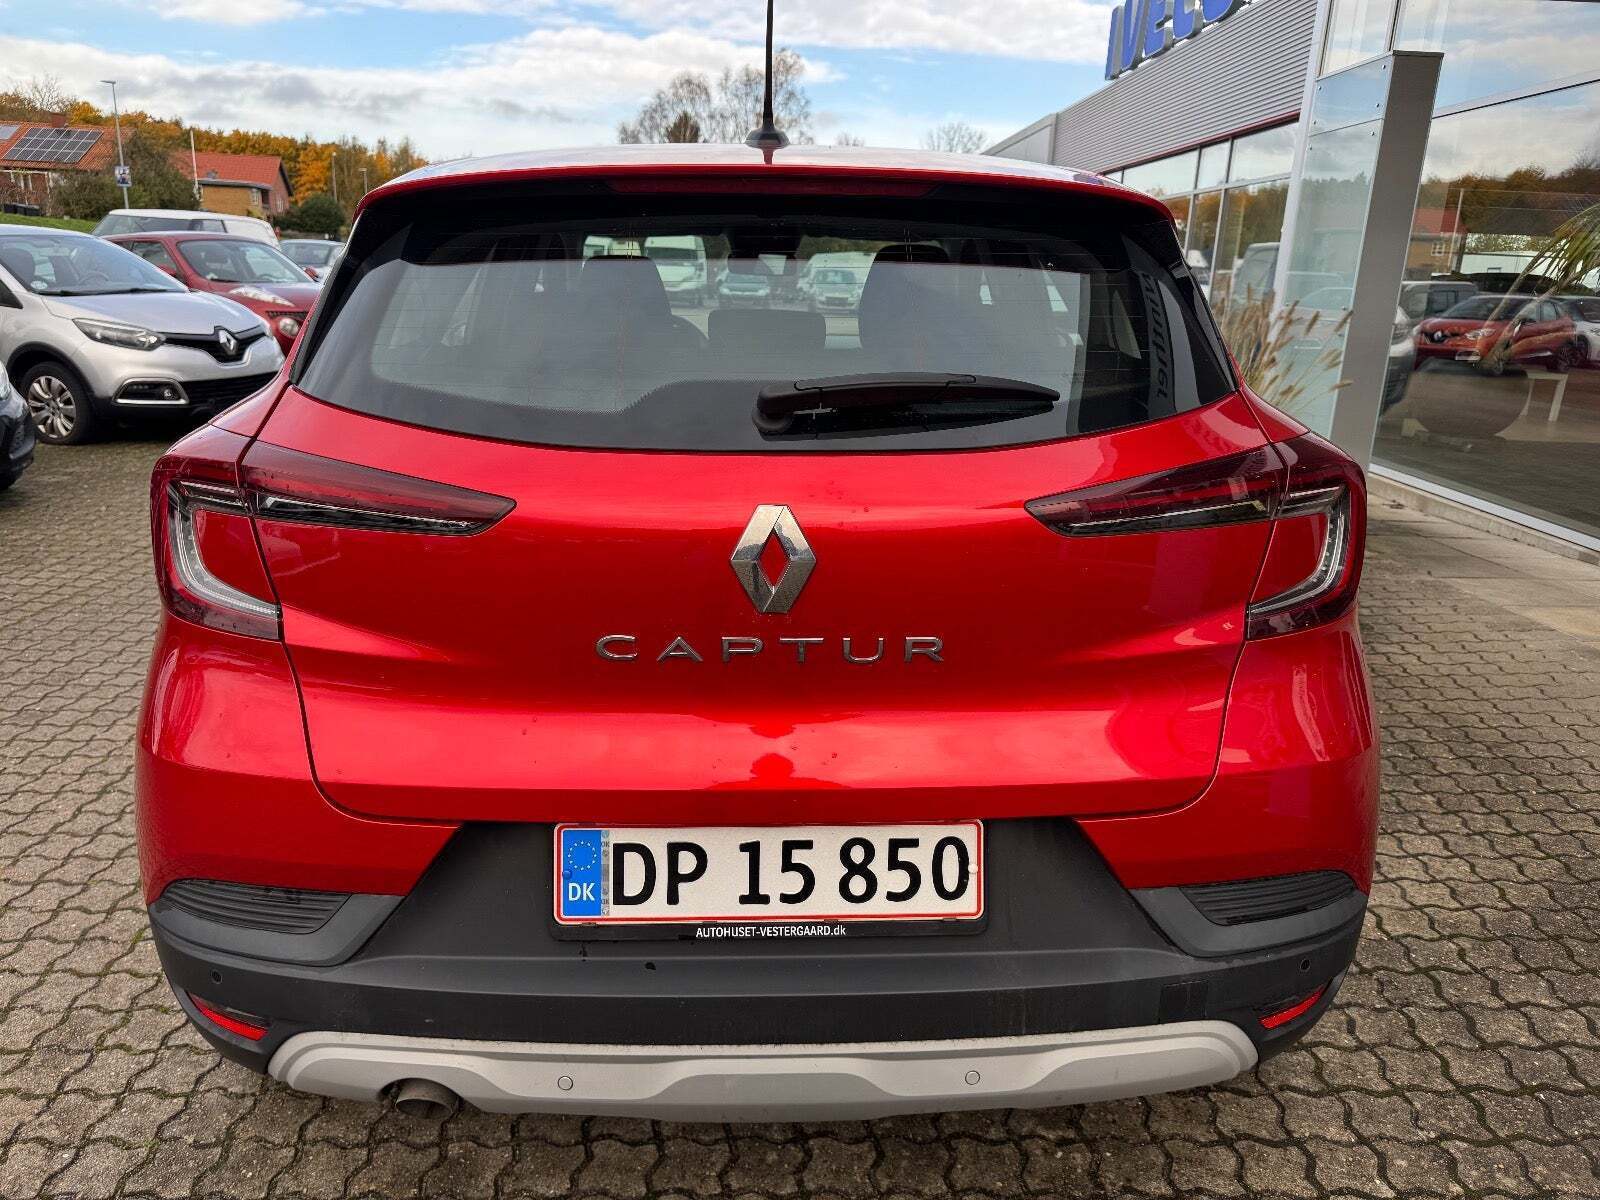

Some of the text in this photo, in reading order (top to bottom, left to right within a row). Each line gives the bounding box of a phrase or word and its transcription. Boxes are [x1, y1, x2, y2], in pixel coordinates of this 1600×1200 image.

[1105, 0, 1240, 80] IVE
[596, 635, 944, 663] CAPTUR
[612, 836, 970, 905] DP 15 850
[568, 882, 595, 901] DK
[696, 925, 847, 938] AUTOHUSET-VESTERGAARD.dk
